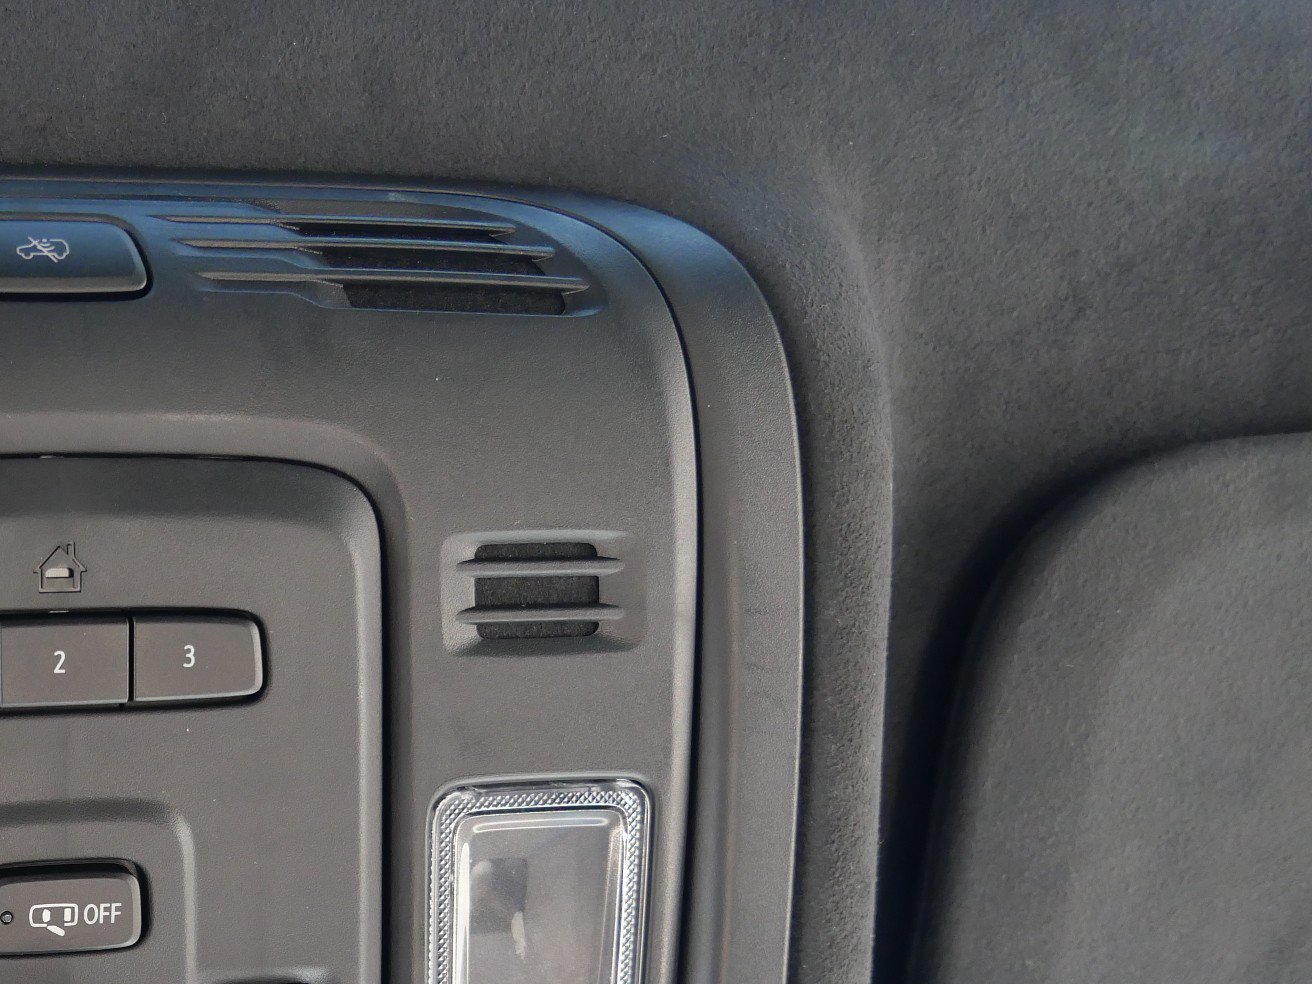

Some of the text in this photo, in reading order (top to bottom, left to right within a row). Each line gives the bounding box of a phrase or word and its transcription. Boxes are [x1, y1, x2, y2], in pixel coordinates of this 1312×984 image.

[53, 650, 66, 674] 2
[182, 644, 196, 668] 3
[83, 903, 122, 925] OFF
